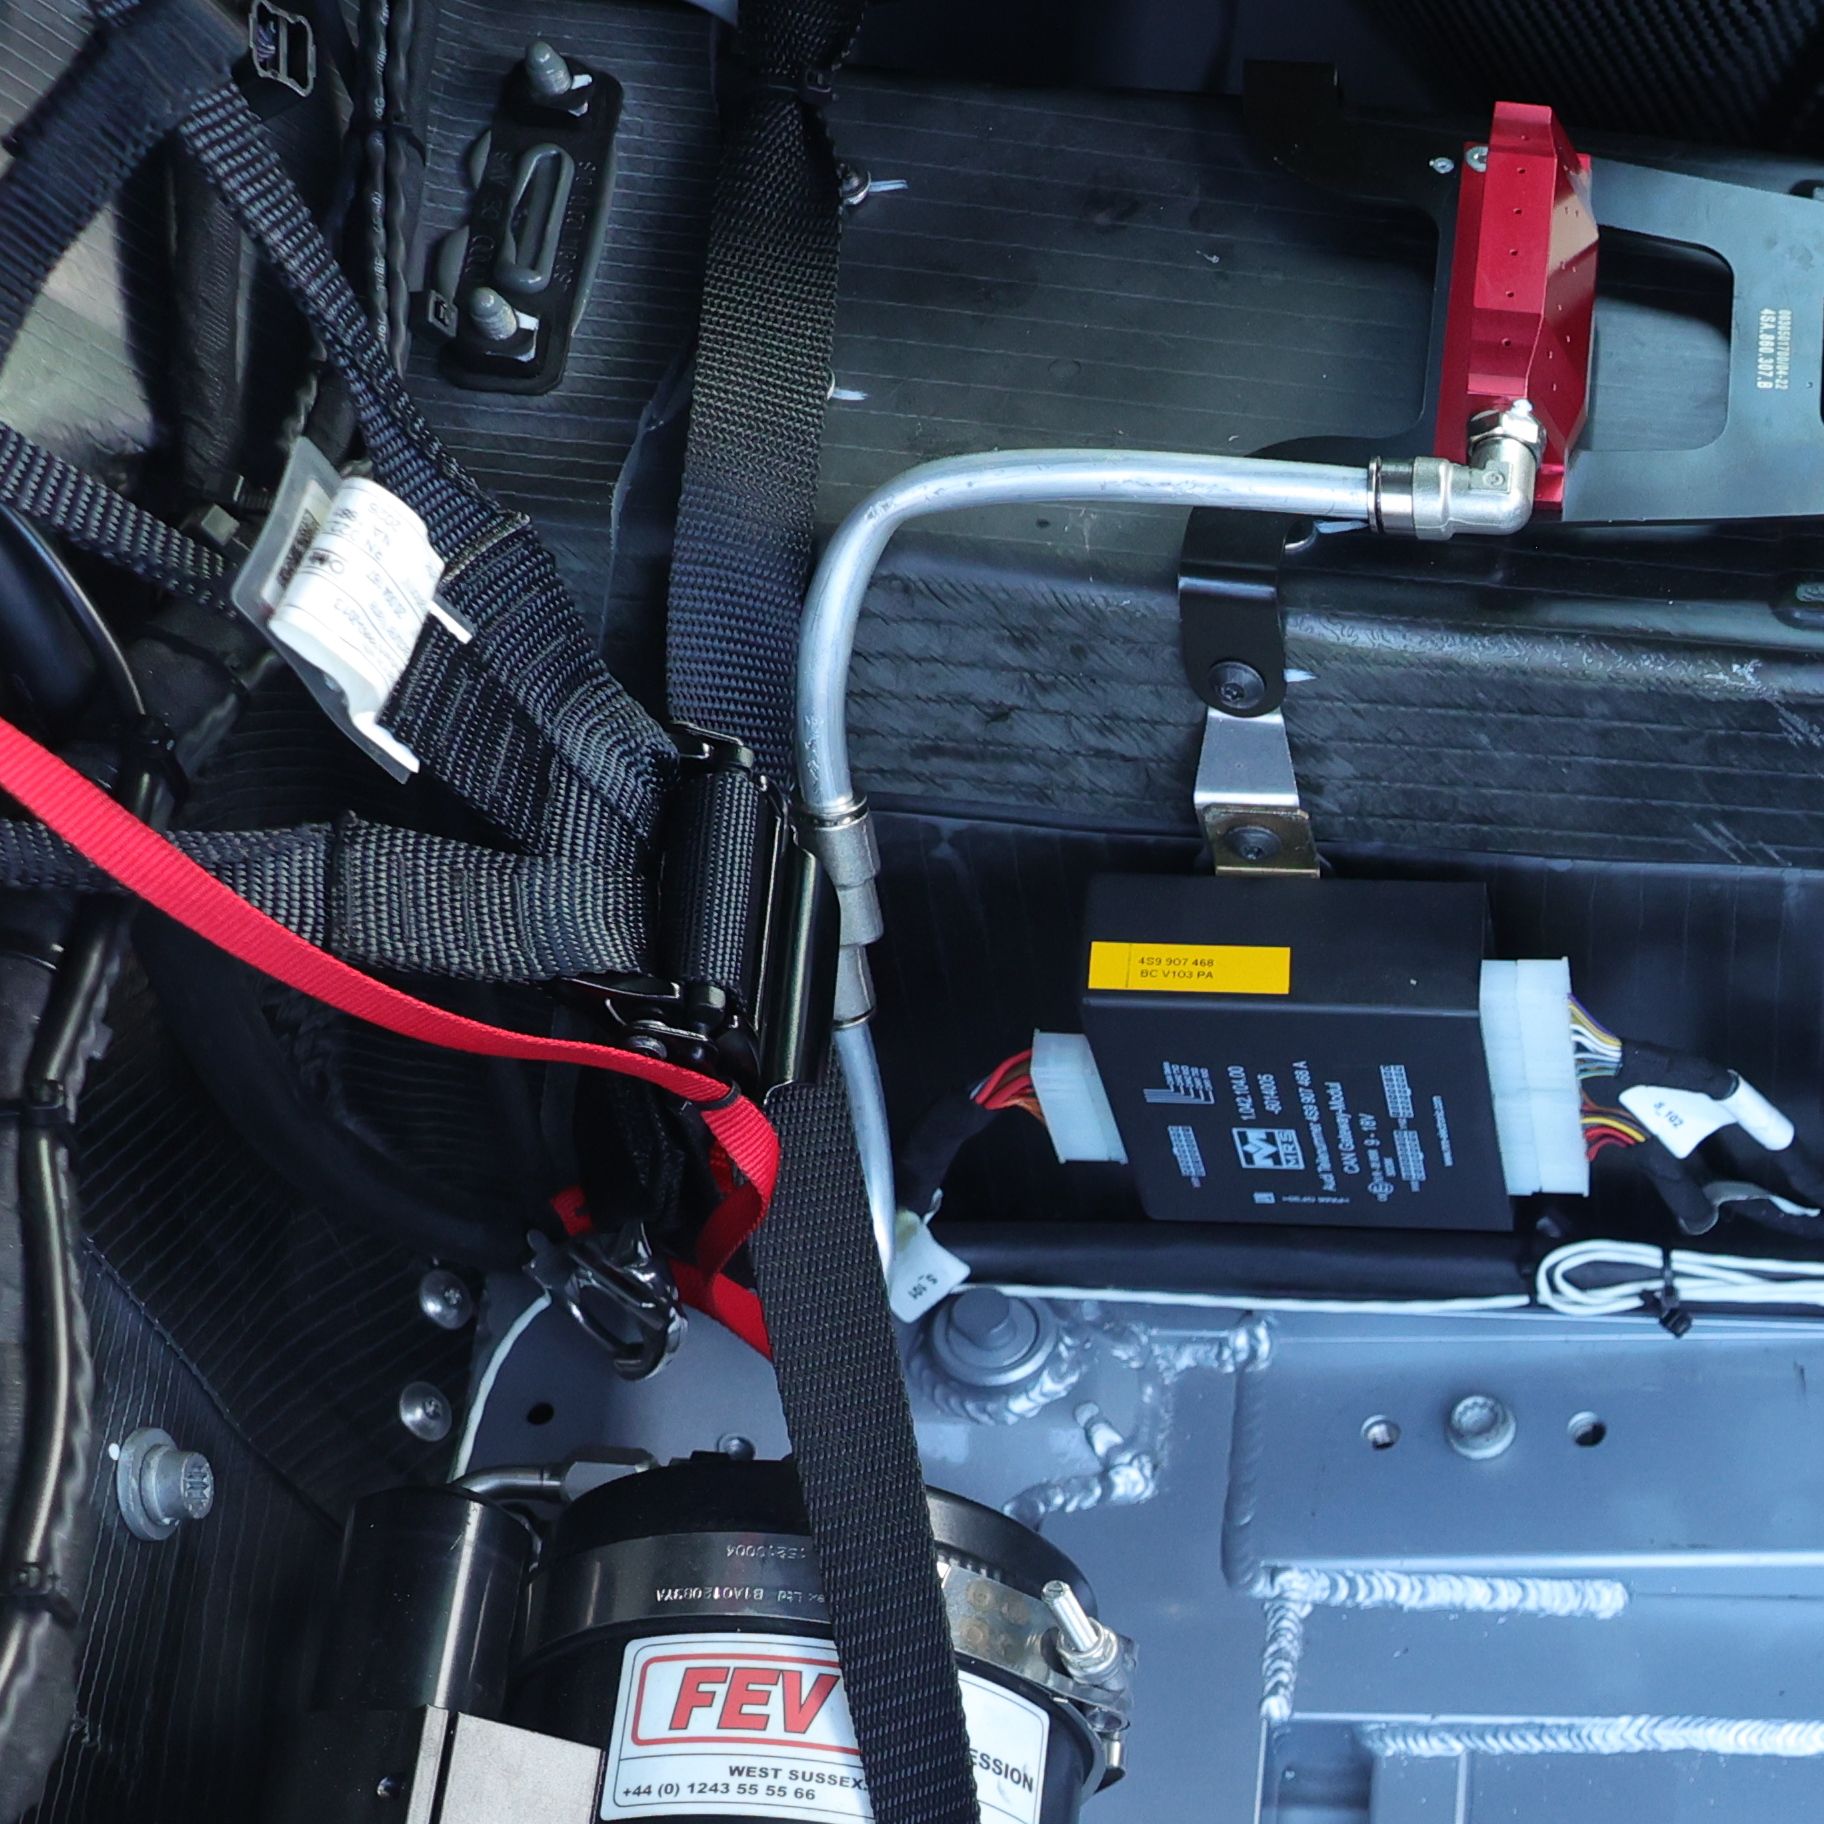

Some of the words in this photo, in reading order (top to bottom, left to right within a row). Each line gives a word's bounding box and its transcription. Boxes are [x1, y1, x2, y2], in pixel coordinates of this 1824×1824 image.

[1138, 957, 1162, 965] 4S9
[1166, 957, 1188, 966] 907
[1192, 958, 1214, 967] 468
[1197, 971, 1214, 979] PA
[1281, 1131, 1301, 1167] MRS
[668, 1667, 841, 1735] FEV
[728, 1764, 782, 1781] WEST
[969, 1748, 1035, 1795] ESSION
[622, 1785, 654, 1798] +44
[657, 1783, 681, 1799] (0)
[687, 1783, 730, 1796] 1243
[736, 1784, 759, 1797] 55
[765, 1785, 788, 1798] 55
[794, 1786, 816, 1801] 66
